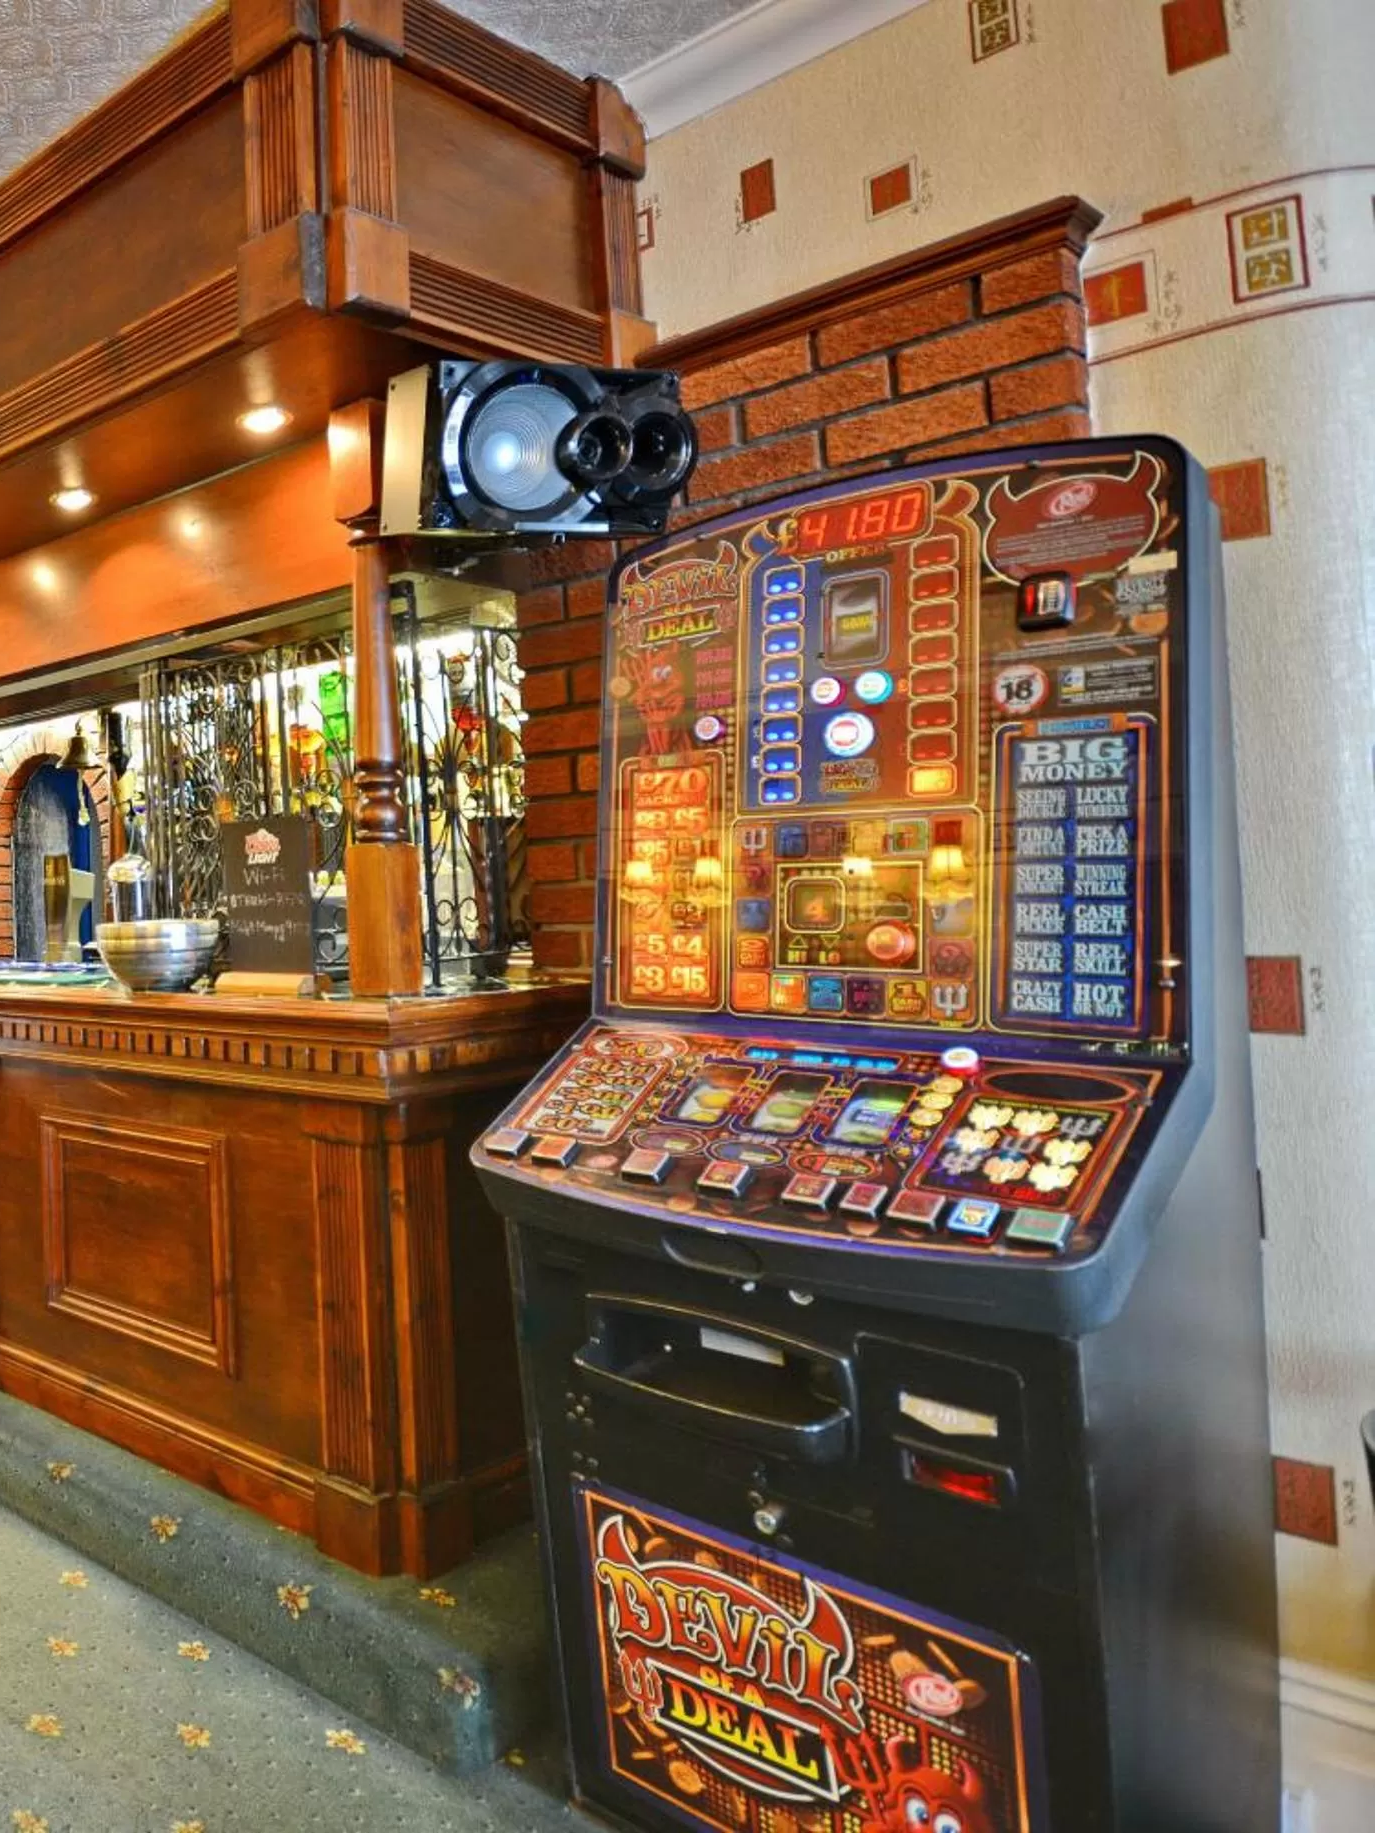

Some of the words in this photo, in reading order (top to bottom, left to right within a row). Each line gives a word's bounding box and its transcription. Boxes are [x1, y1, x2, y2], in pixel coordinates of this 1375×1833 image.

[825, 542, 887, 562] OFFER
[646, 613, 714, 641] DEAL
[1000, 679, 1033, 702] 18
[1020, 738, 1128, 766] BIG
[1018, 762, 1126, 783] MONEY
[1017, 787, 1065, 806] SEEING
[1077, 784, 1127, 806] LUCKY
[1077, 825, 1109, 842] PICK
[1077, 839, 1128, 858] PRIZE
[1016, 864, 1064, 882] SUPER
[1076, 863, 1127, 881] WINNING
[1075, 879, 1127, 897] STREAK
[1017, 902, 1065, 921] REEL
[1075, 904, 1126, 921] CASH
[1074, 919, 1127, 937] BELT
[1015, 941, 1062, 959] SUPER
[1074, 942, 1126, 960] REEL
[1013, 957, 1063, 974] STAR
[1074, 958, 1126, 977] SKILL
[1013, 979, 1062, 998] CRAZY
[1074, 982, 1124, 1005] HOT
[1012, 995, 1062, 1013] CASH
[1074, 1001, 1090, 1015] OR
[1092, 1003, 1124, 1018] NOT
[699, 1666, 735, 1692] OF
[743, 1682, 766, 1708] A
[665, 1676, 819, 1780] DEAL
